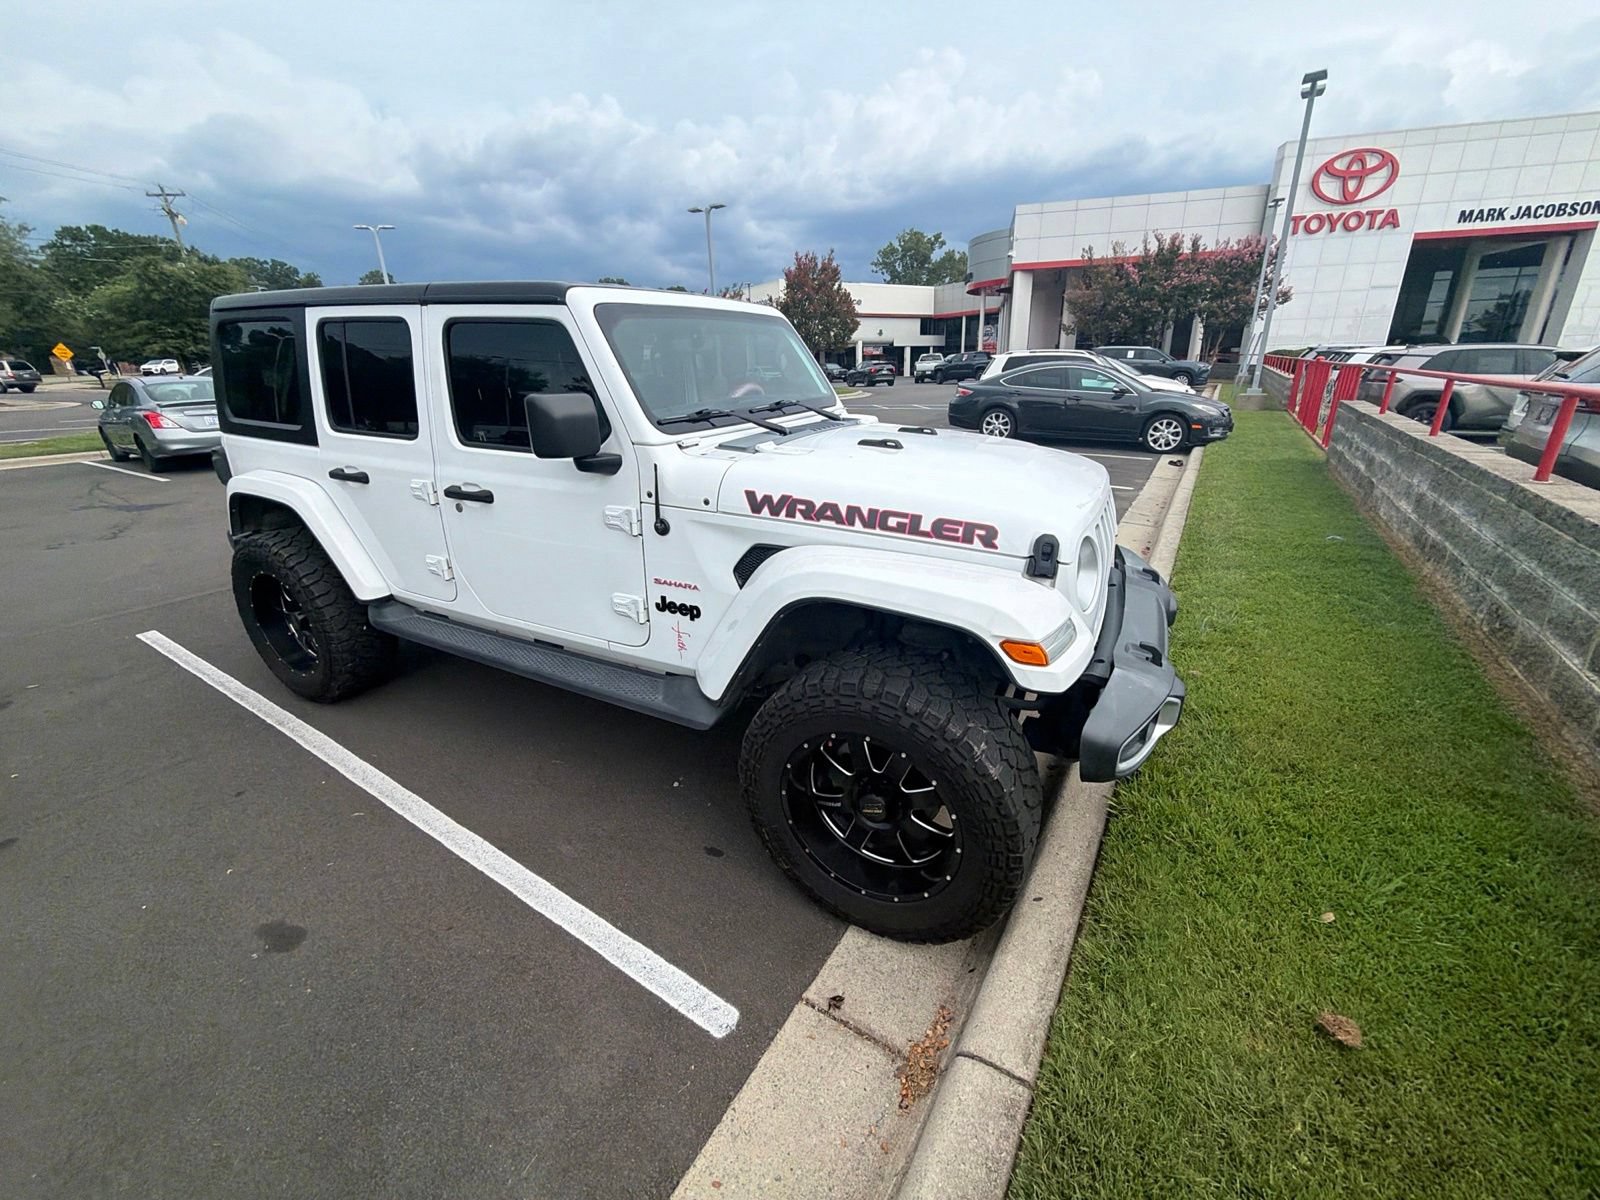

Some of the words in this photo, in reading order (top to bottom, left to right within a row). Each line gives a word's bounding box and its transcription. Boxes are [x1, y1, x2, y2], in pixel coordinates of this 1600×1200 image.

[1291, 208, 1400, 235] TOYOTA
[1457, 206, 1509, 224] MARK
[744, 489, 999, 550] WRANGLER
[653, 577, 701, 592] SAHARA
[655, 595, 701, 621] Jeep
